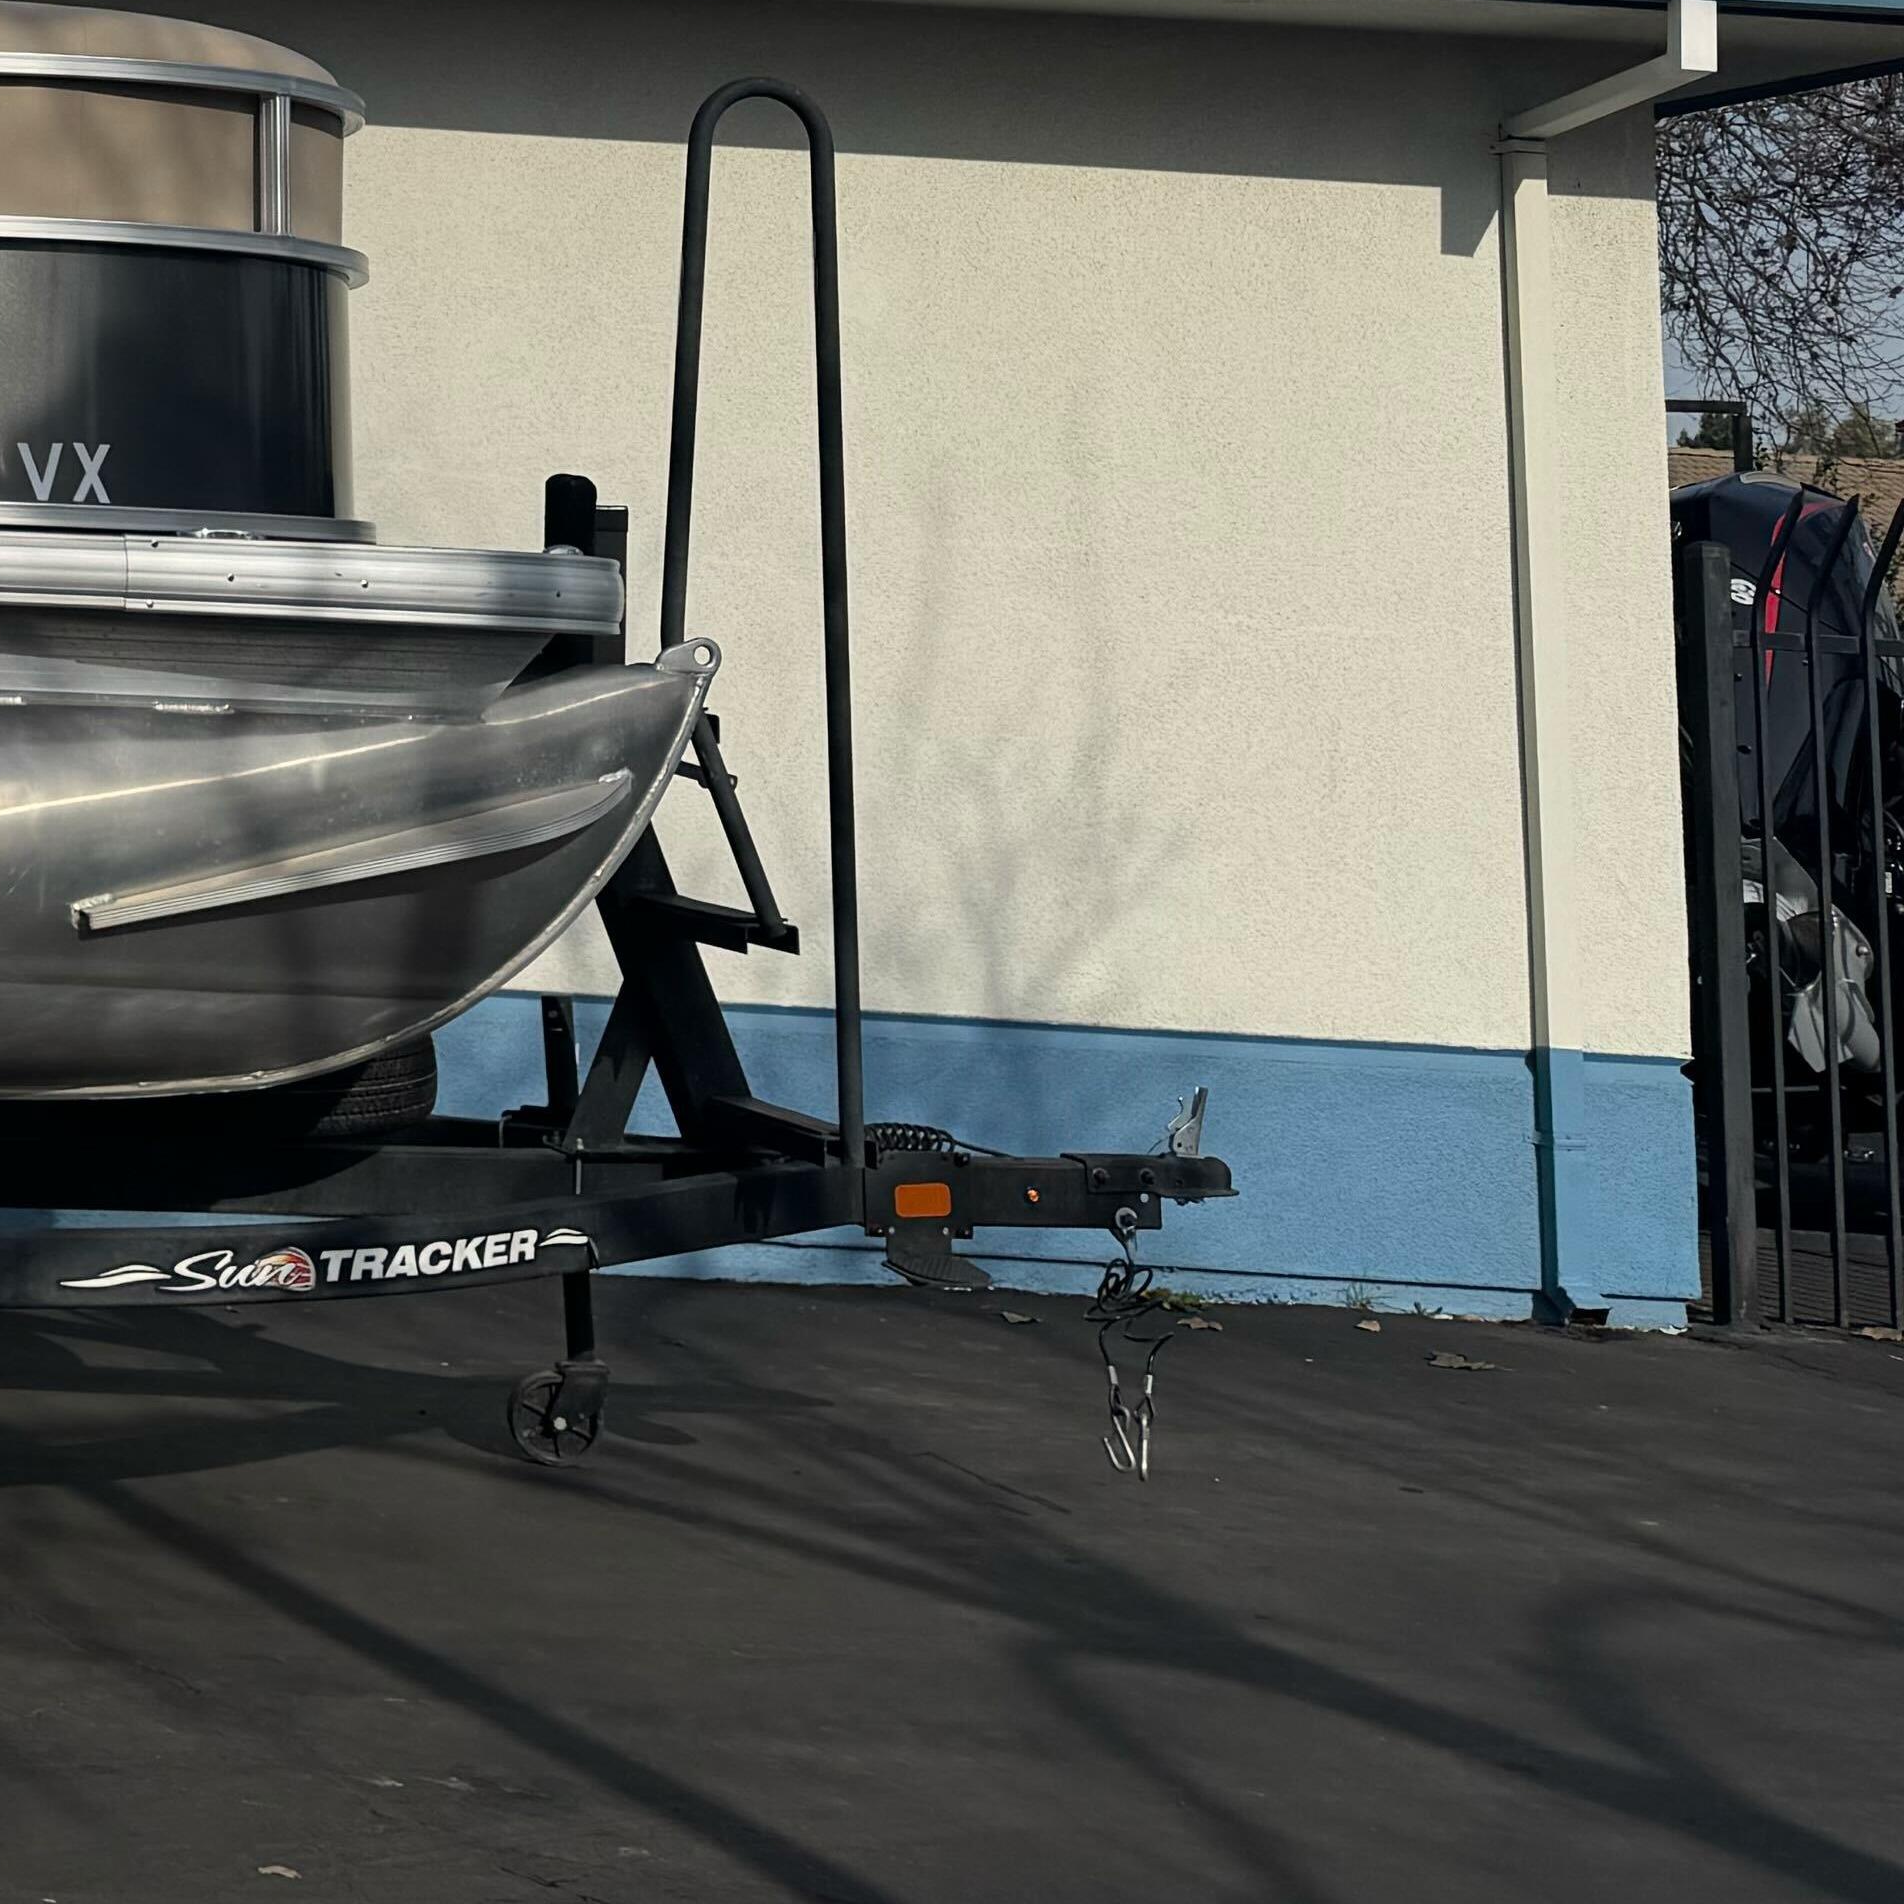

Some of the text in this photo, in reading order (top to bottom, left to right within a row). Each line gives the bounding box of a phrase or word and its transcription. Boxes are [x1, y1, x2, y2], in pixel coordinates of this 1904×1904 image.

[17, 442, 111, 504] VX
[157, 1228, 538, 1292] Sun TRACKER
